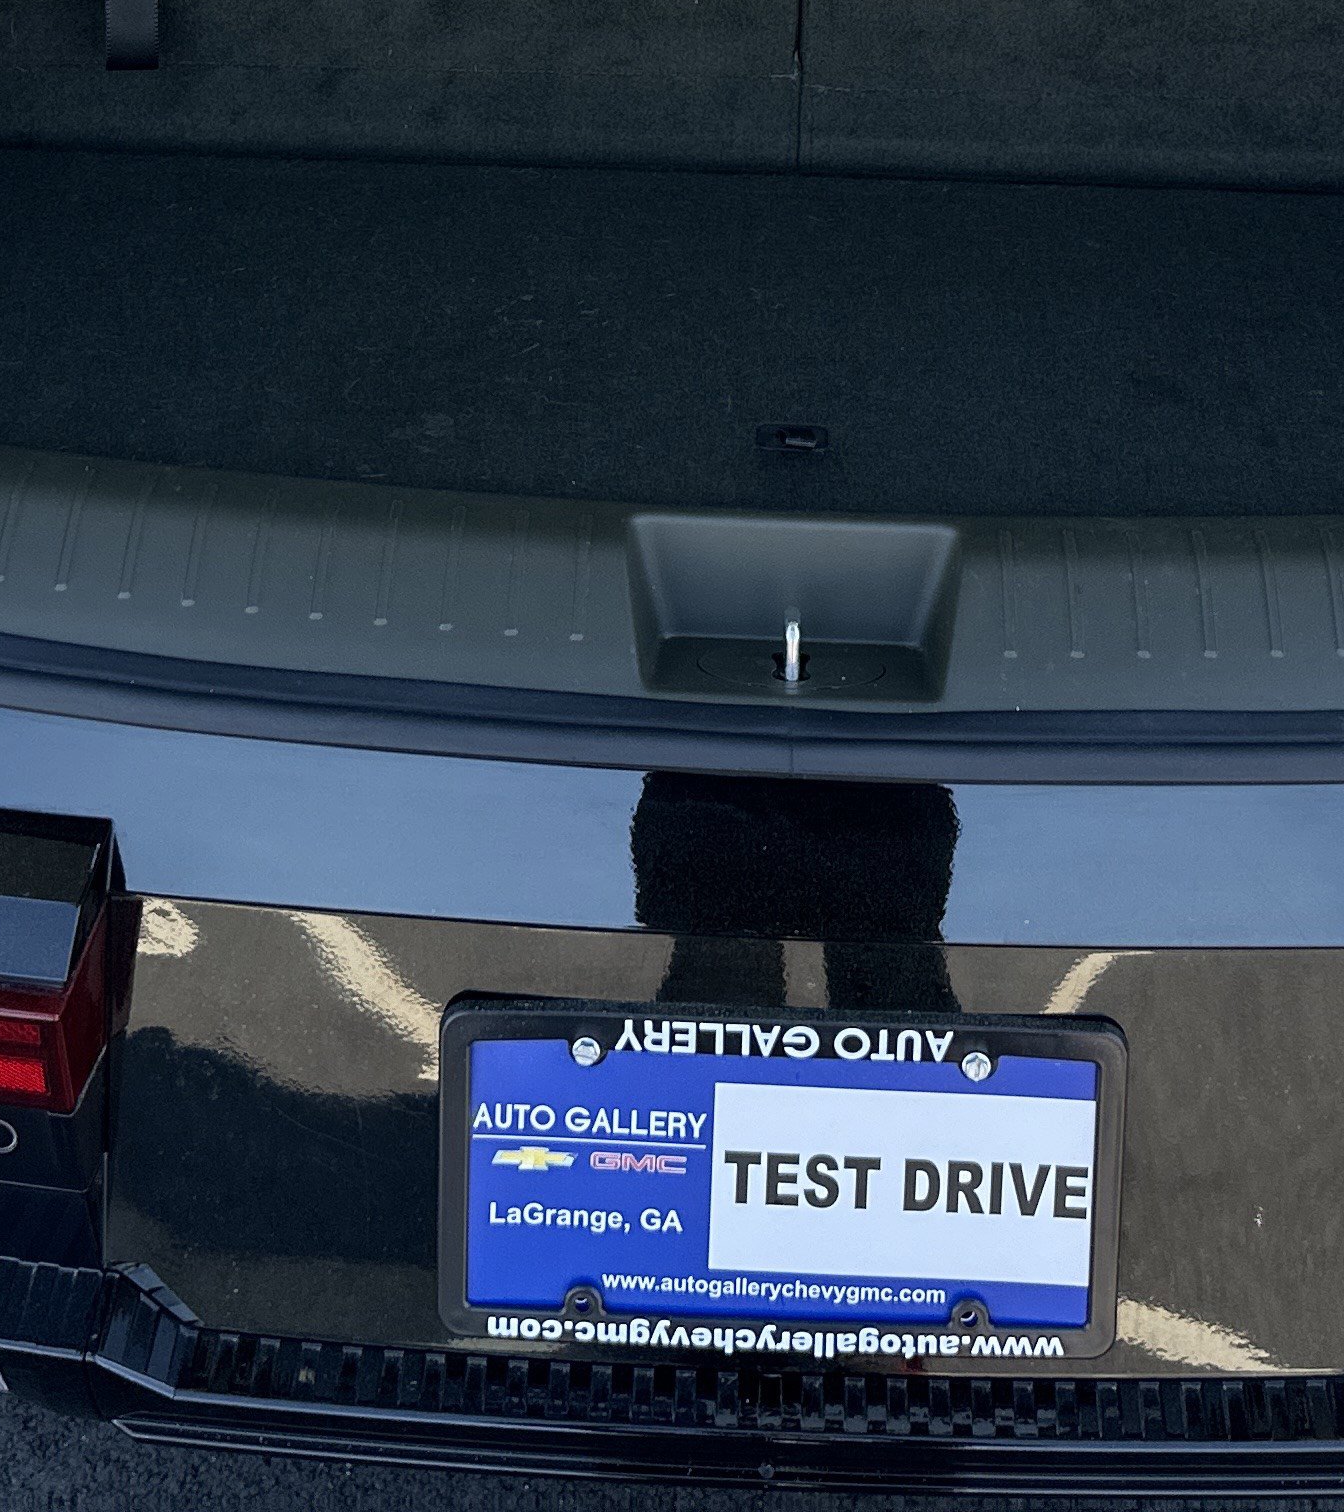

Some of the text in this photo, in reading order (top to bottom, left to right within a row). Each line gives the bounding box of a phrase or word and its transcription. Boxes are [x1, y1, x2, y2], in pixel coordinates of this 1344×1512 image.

[614, 1018, 954, 1063] AUTO GALLERY
[472, 1102, 708, 1140] AUTO GALLERY
[589, 1151, 687, 1175] GMC
[724, 1149, 1089, 1220] TEST DRIVE
[489, 1201, 683, 1234] LaGrange, GA
[601, 1271, 946, 1305] www.autogallerychevygmc.com
[487, 1315, 1065, 1359] www.autogallerychevygmc.com
